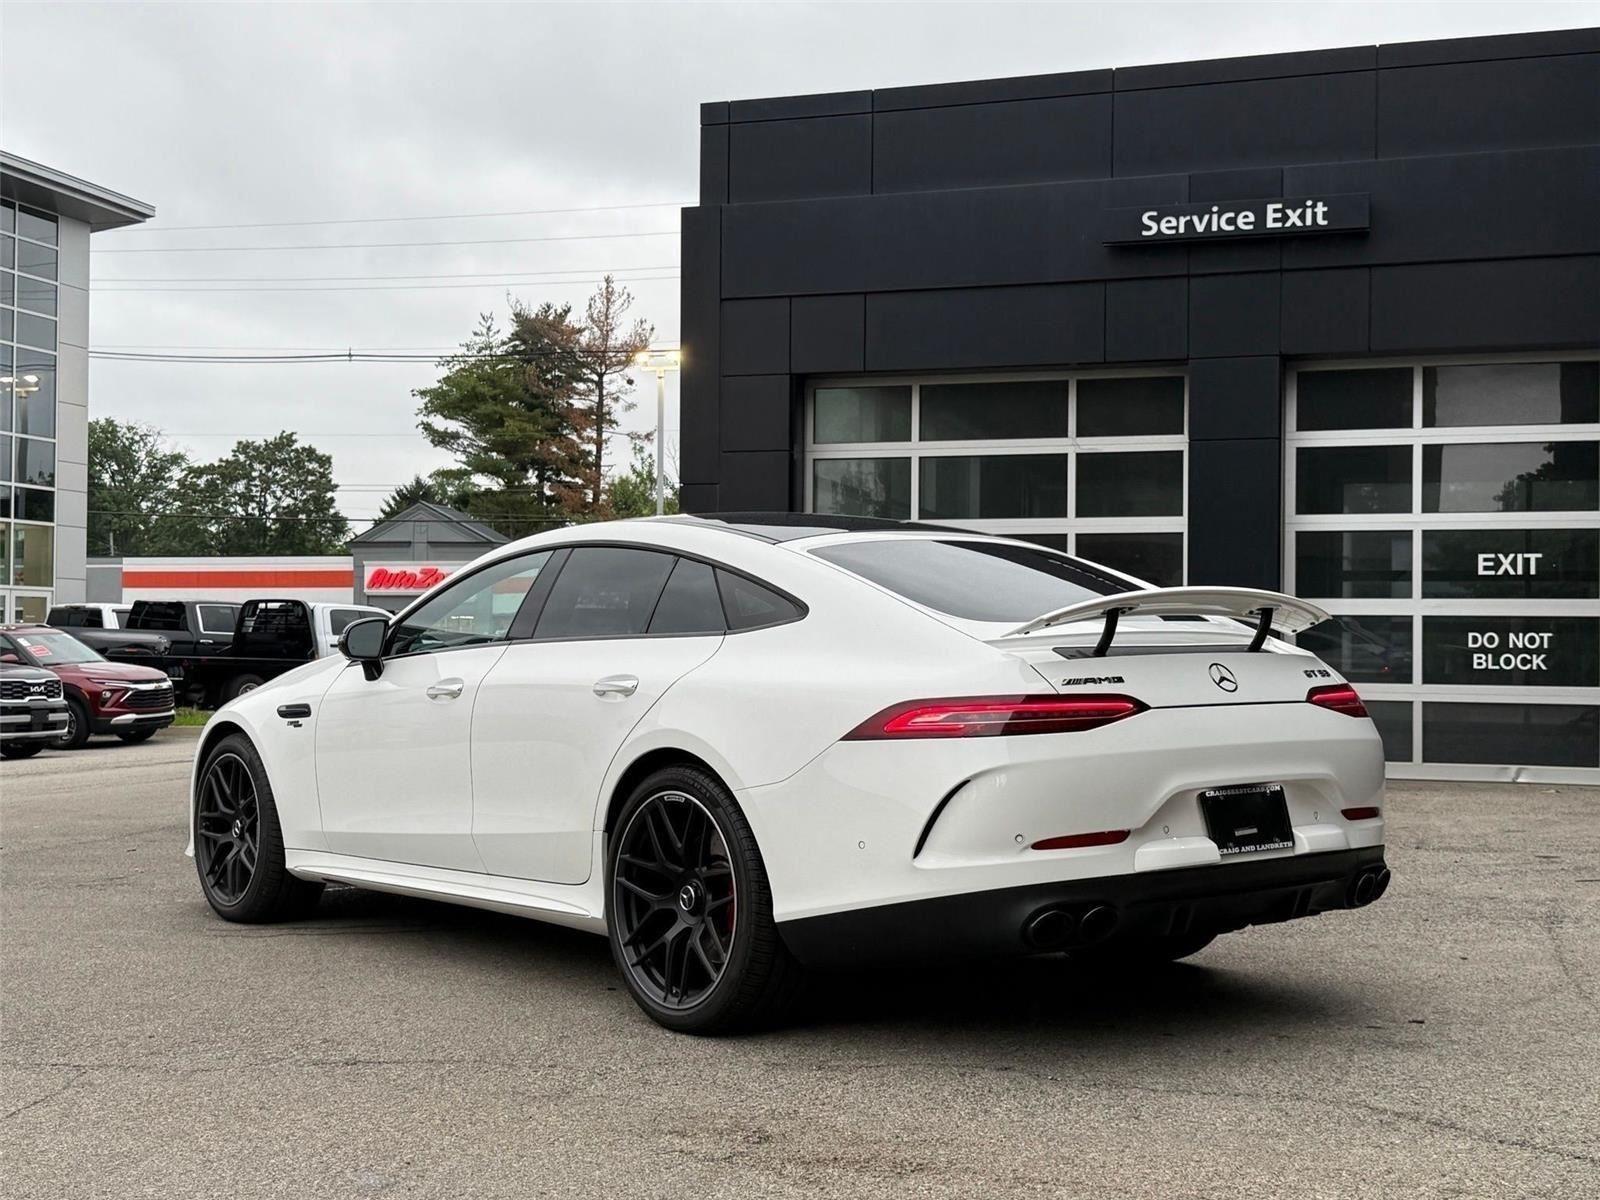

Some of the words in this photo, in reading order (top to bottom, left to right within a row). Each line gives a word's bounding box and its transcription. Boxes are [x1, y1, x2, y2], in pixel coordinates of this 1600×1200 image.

[1141, 205, 1255, 236] Service
[1266, 200, 1328, 228] Exit
[1477, 553, 1543, 576] EXIT
[367, 567, 450, 590] AutoZo
[1467, 632, 1500, 649] DO
[1508, 632, 1553, 649] NOT
[1472, 653, 1548, 671] BLOCK
[1083, 676, 1125, 685] AMG
[1303, 669, 1318, 678] GT
[1219, 846, 1240, 855] CRAIG
[1240, 844, 1256, 852] AND
